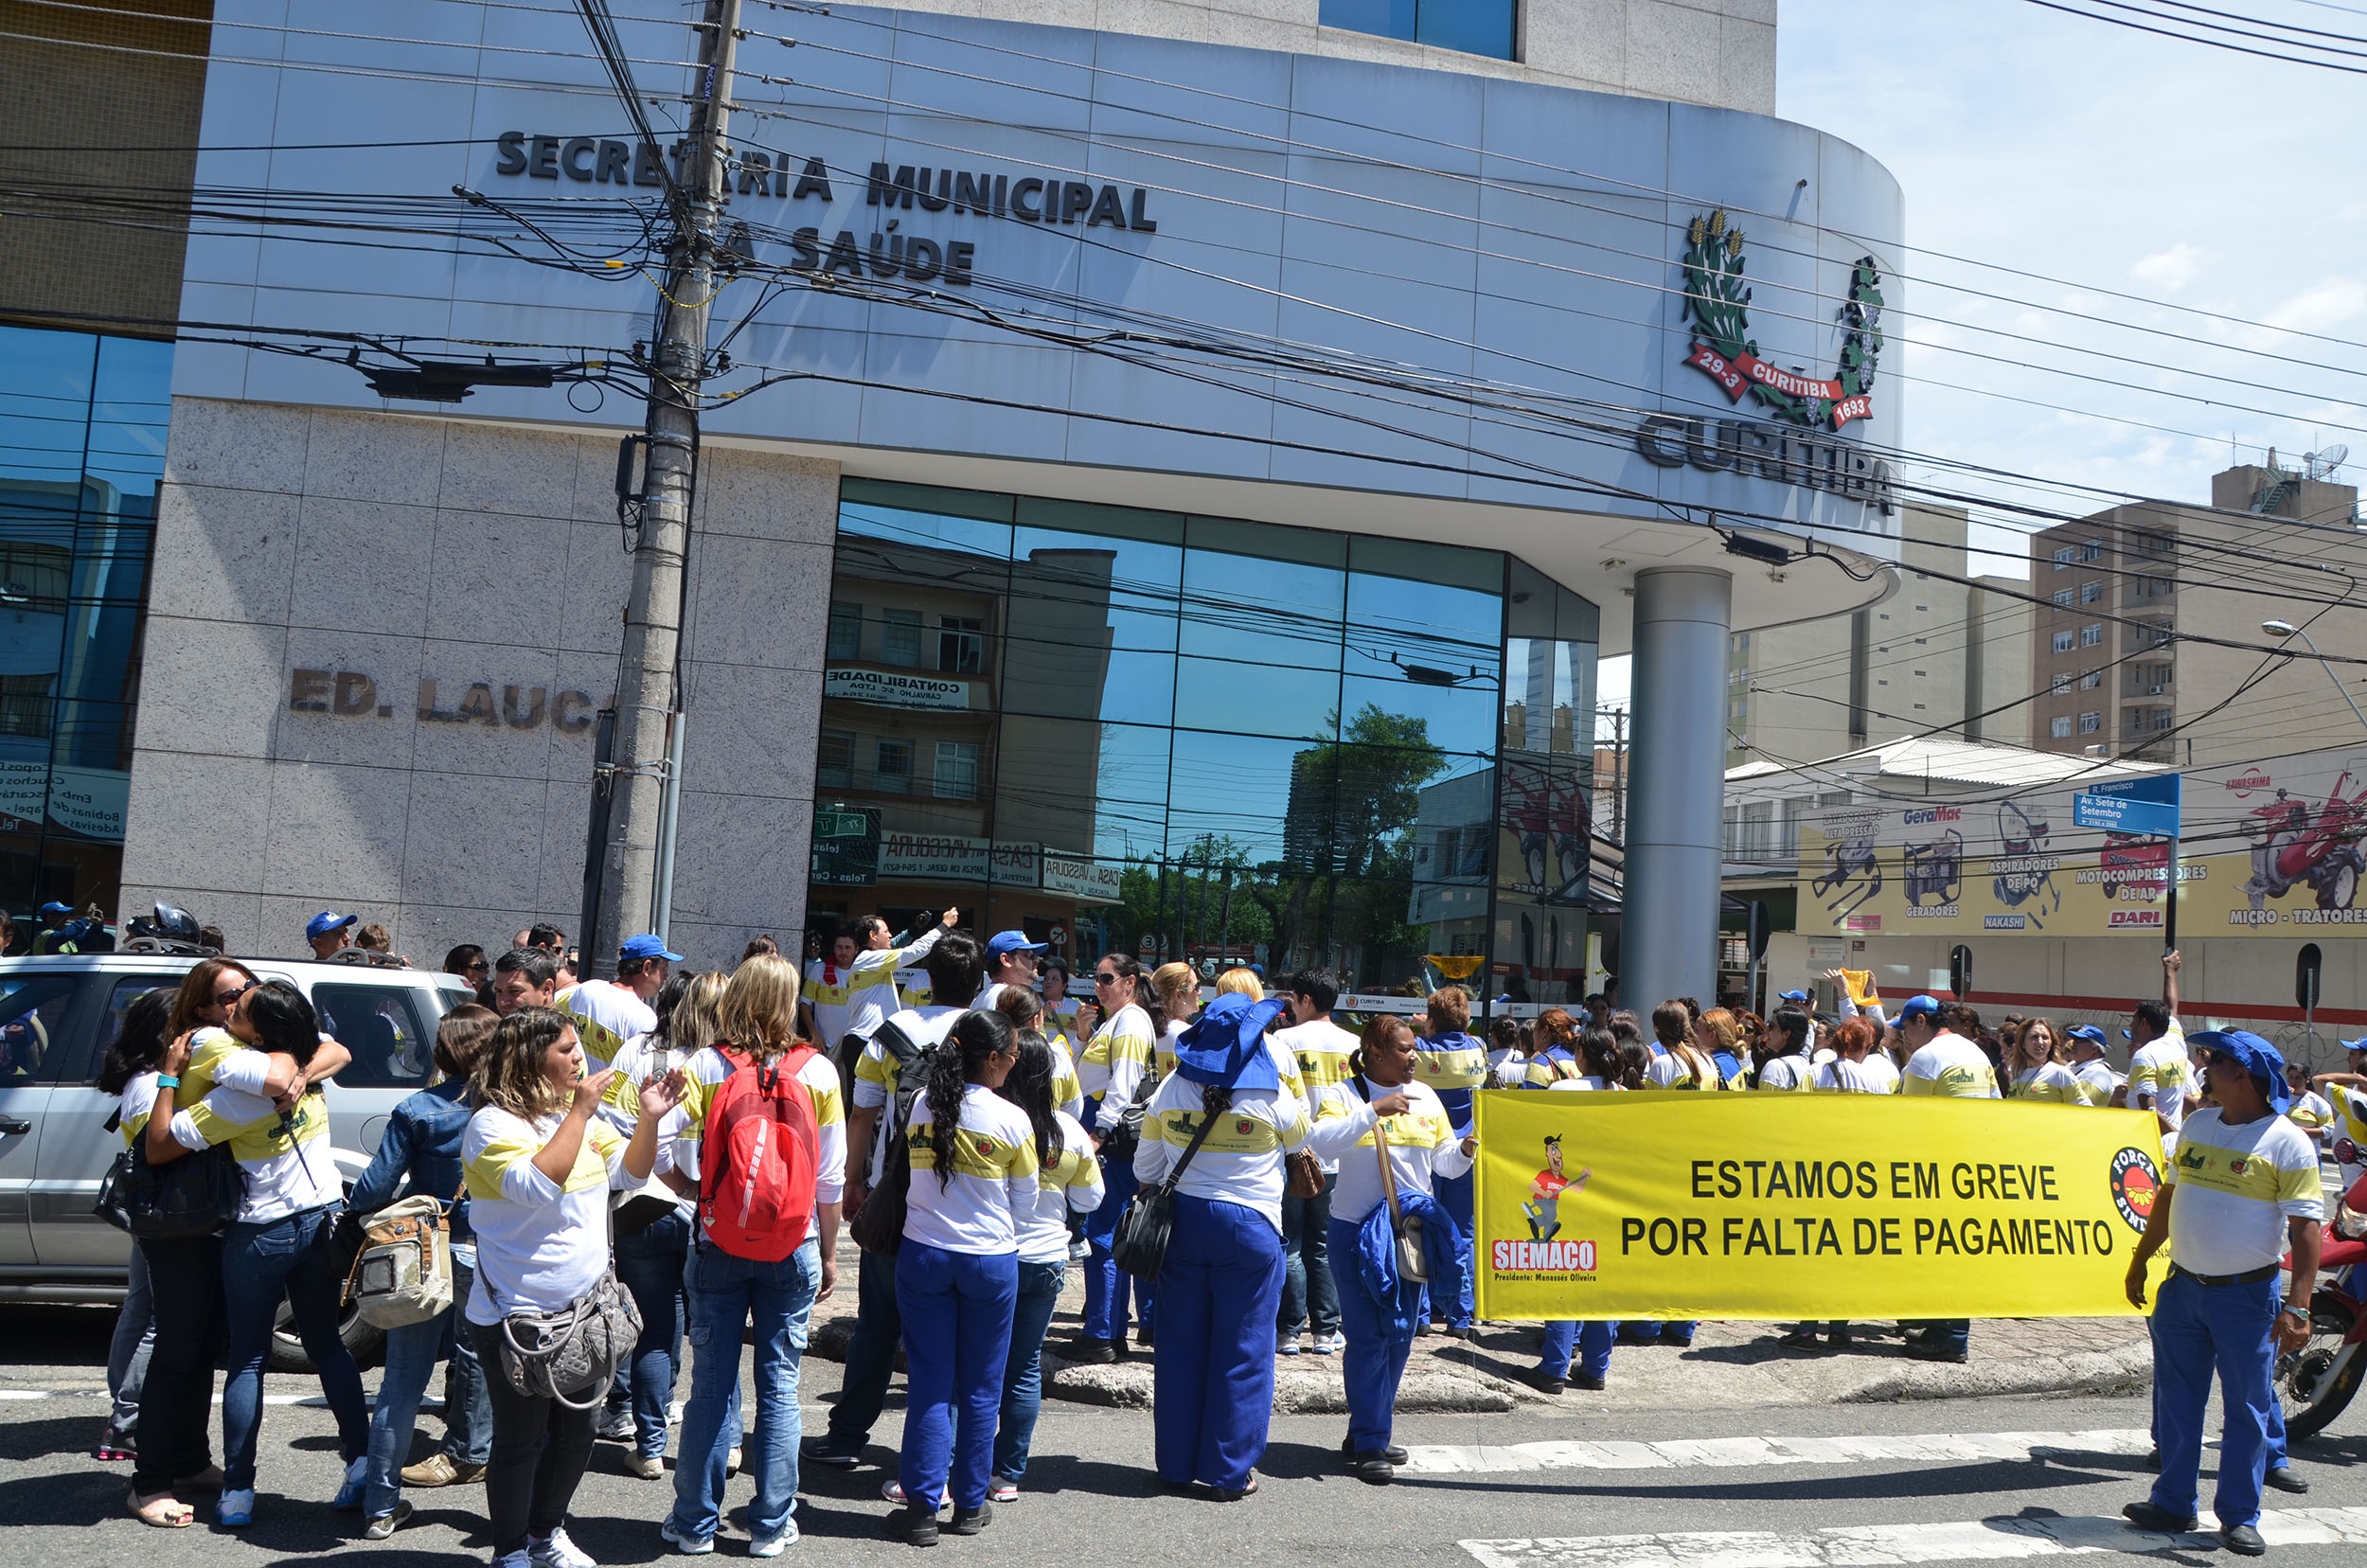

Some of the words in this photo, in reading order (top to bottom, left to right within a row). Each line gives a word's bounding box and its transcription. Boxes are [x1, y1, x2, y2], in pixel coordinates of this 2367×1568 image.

[496, 131, 833, 202] SECRERIA
[865, 162, 1158, 233] MUNICIPAL
[790, 218, 975, 287] SAÚDE
[1699, 350, 1740, 387] 29-3
[1752, 363, 1830, 398] CURITIBA
[1835, 398, 1865, 421] 1693
[1638, 415, 1895, 516] CURITIBA
[289, 668, 393, 718] ED.
[418, 678, 620, 734] LAUC
[2101, 781, 2134, 793] Francisco
[2226, 775, 2270, 791] KAWASHIMA
[2080, 796, 2093, 805] Av.
[2095, 798, 2114, 809] Sete
[2116, 801, 2127, 810] de
[1824, 811, 1875, 826] LAVADORAS
[1903, 806, 1962, 825] GeraMac
[2080, 806, 2122, 819] Setembro
[1824, 829, 1843, 840] ALTA
[1844, 823, 1880, 839] PRESSÃO
[1989, 858, 2059, 873] ASPIRADORES
[2076, 865, 2207, 883] MOTOCOMPRESORES
[2006, 877, 2021, 889] DE
[2121, 888, 2137, 900] DE
[2139, 888, 2157, 900] AR
[1906, 906, 1958, 918] GERADORES
[2110, 911, 2160, 923] DARI
[2230, 910, 2277, 924] MICRO
[1985, 917, 2024, 929] NAKASHI
[2112, 1149, 2155, 1178] FORÇA
[1692, 1160, 1878, 1199] ESTAMOS
[1893, 1162, 1938, 1200] EM
[1954, 1163, 2058, 1202] GREVE
[1622, 1218, 1707, 1256] POR
[1723, 1218, 1842, 1256] FALTA
[1855, 1218, 1902, 1256] DE
[1915, 1220, 2113, 1256] PAGAMENTO
[1494, 1241, 1594, 1270] SIEMACO
[1494, 1273, 1533, 1281] Presidente:
[1535, 1274, 1568, 1282] Manassés
[1570, 1274, 1597, 1282] Oliveira
